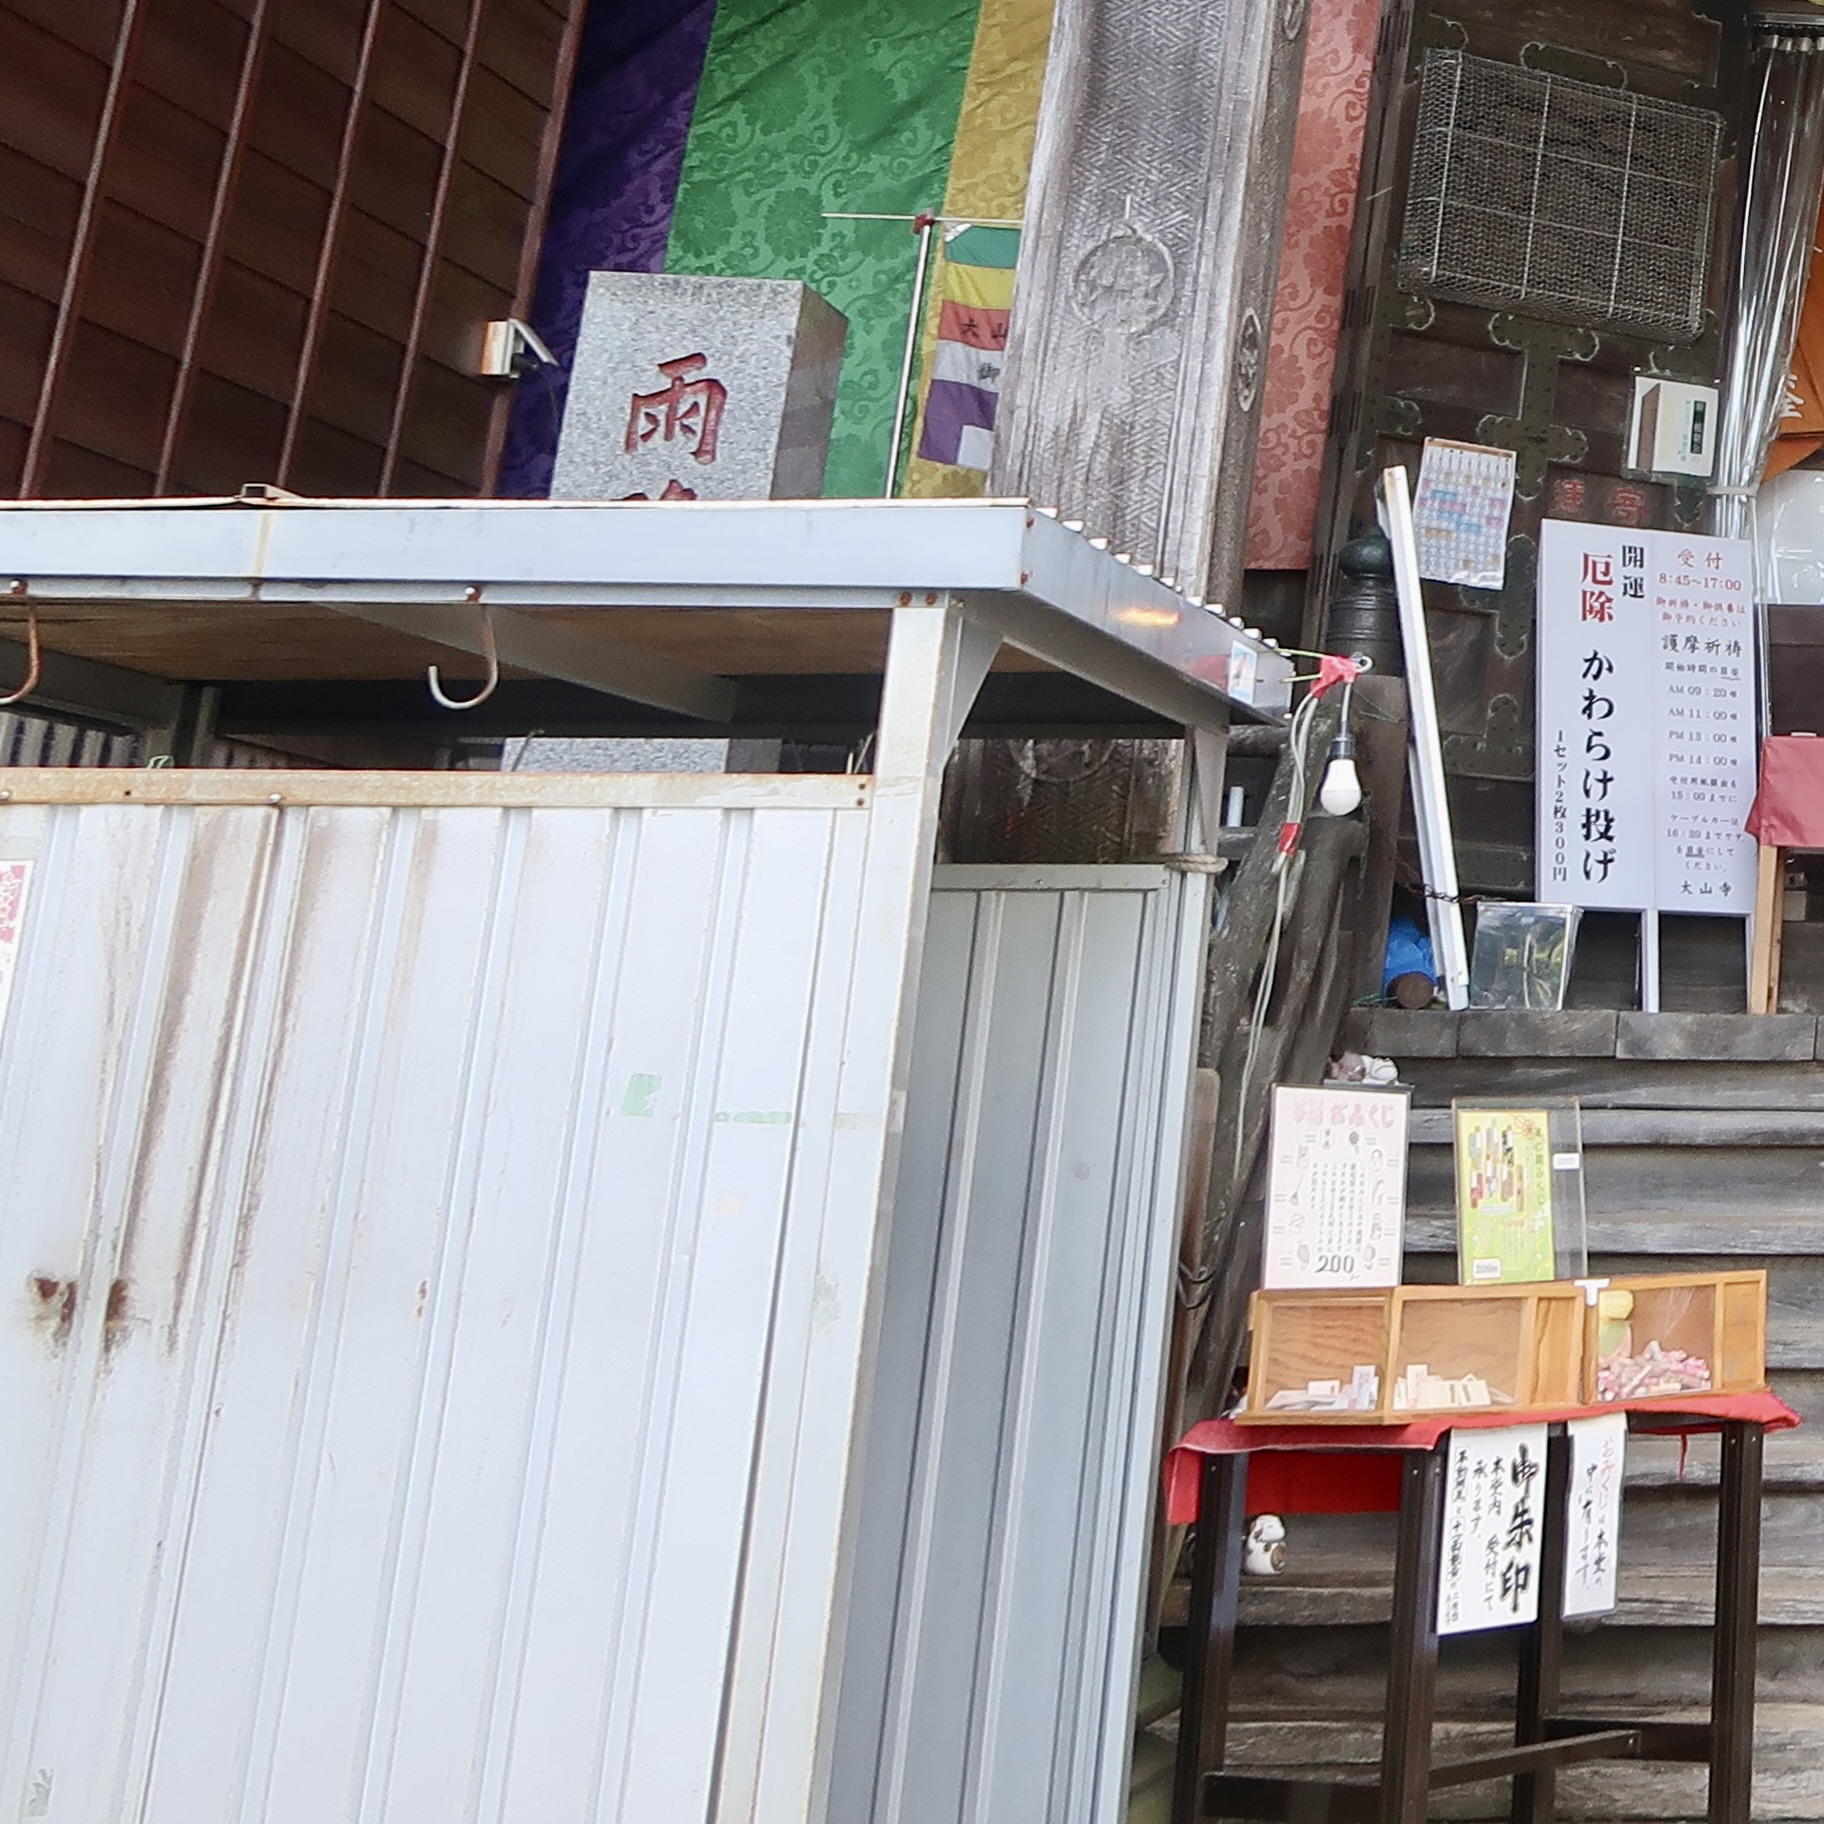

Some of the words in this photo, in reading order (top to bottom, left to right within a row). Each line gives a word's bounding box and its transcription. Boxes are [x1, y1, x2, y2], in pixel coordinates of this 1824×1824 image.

[608, 352, 728, 500] 雨
[1580, 552, 1615, 624] 厄除
[1621, 544, 1645, 599] 開運
[1676, 547, 1724, 571] 受付
[1580, 649, 1617, 885] かわらけ投げ
[1680, 880, 1732, 897] 大山寺
[1499, 1442, 1540, 1614] 御朱印
